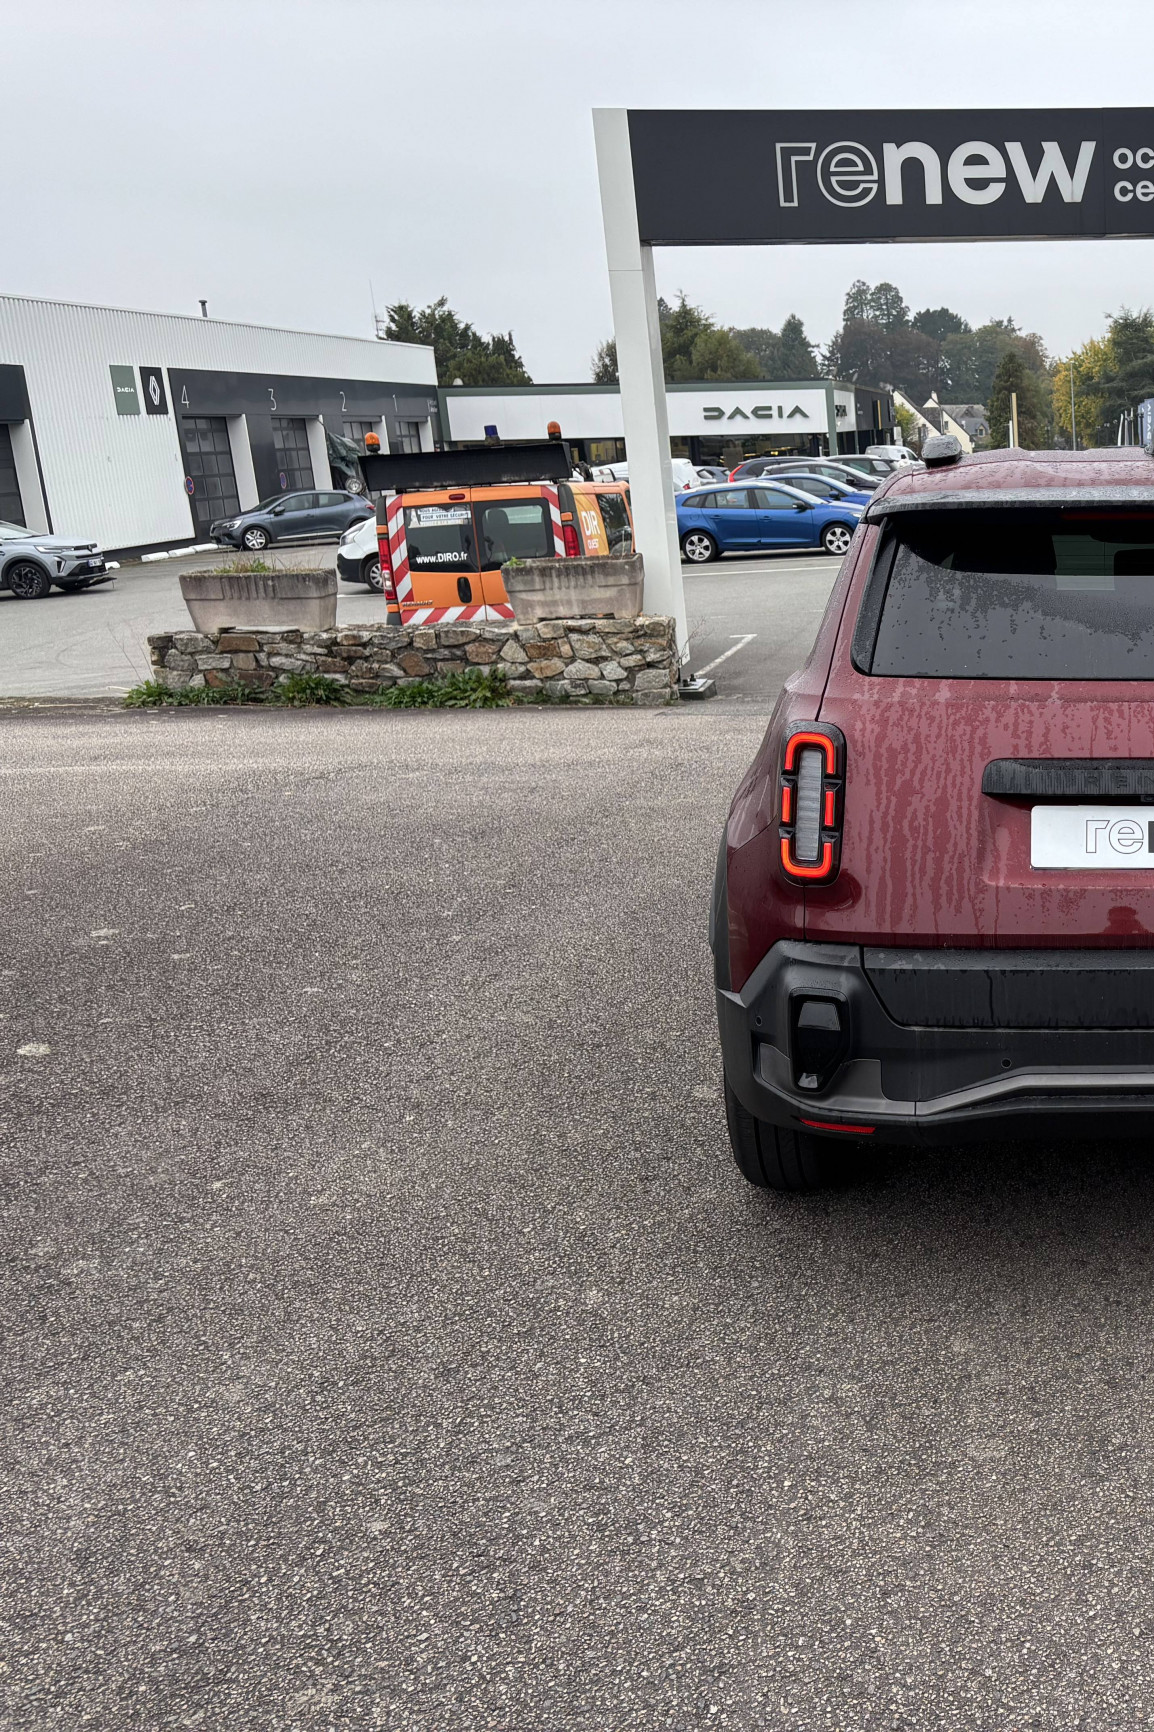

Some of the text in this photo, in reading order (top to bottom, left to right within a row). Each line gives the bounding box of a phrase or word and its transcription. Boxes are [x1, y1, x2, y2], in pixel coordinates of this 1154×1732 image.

[775, 140, 1097, 207] renew
[181, 385, 190, 408] 4
[268, 388, 277, 410] 3
[340, 391, 347, 412] 2
[392, 394, 398, 412] 1
[703, 405, 810, 420] DACIA
[581, 510, 600, 536] DIR
[415, 551, 468, 564] www.DIRO.fr
